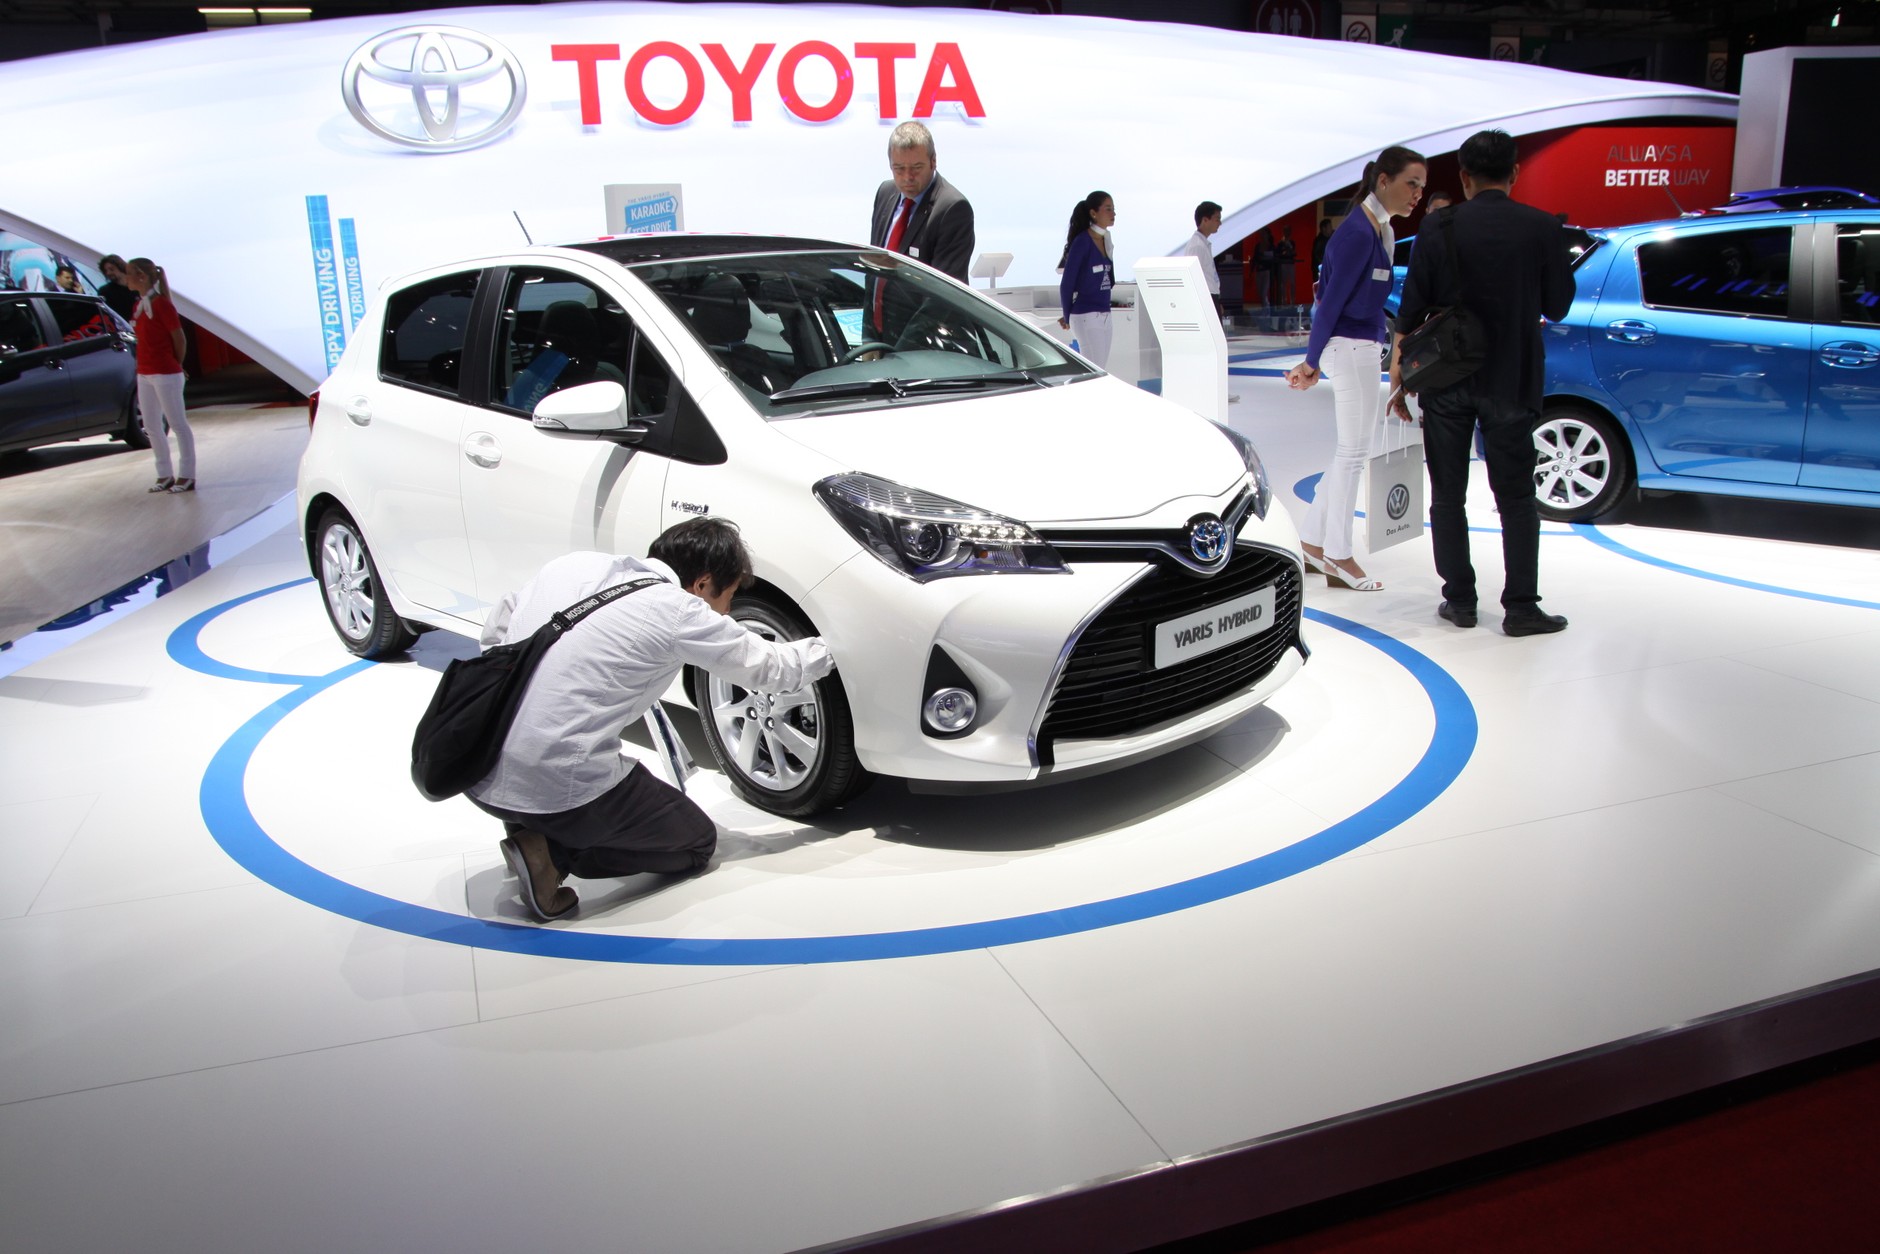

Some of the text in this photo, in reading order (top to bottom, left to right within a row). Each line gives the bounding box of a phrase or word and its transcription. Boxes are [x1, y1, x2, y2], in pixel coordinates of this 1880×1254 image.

[551, 40, 987, 125] TOYOTA
[1607, 145, 1692, 162] ALWAYS A
[1605, 168, 1711, 187] BETTER WAY
[631, 200, 671, 221] KARAOKE
[650, 220, 672, 232] DRIVE
[345, 256, 364, 315] DRIVING
[316, 248, 343, 374] PPY DRIVING
[564, 598, 599, 621] MOSCHINO
[1174, 604, 1262, 648] YARIS HYBRID
